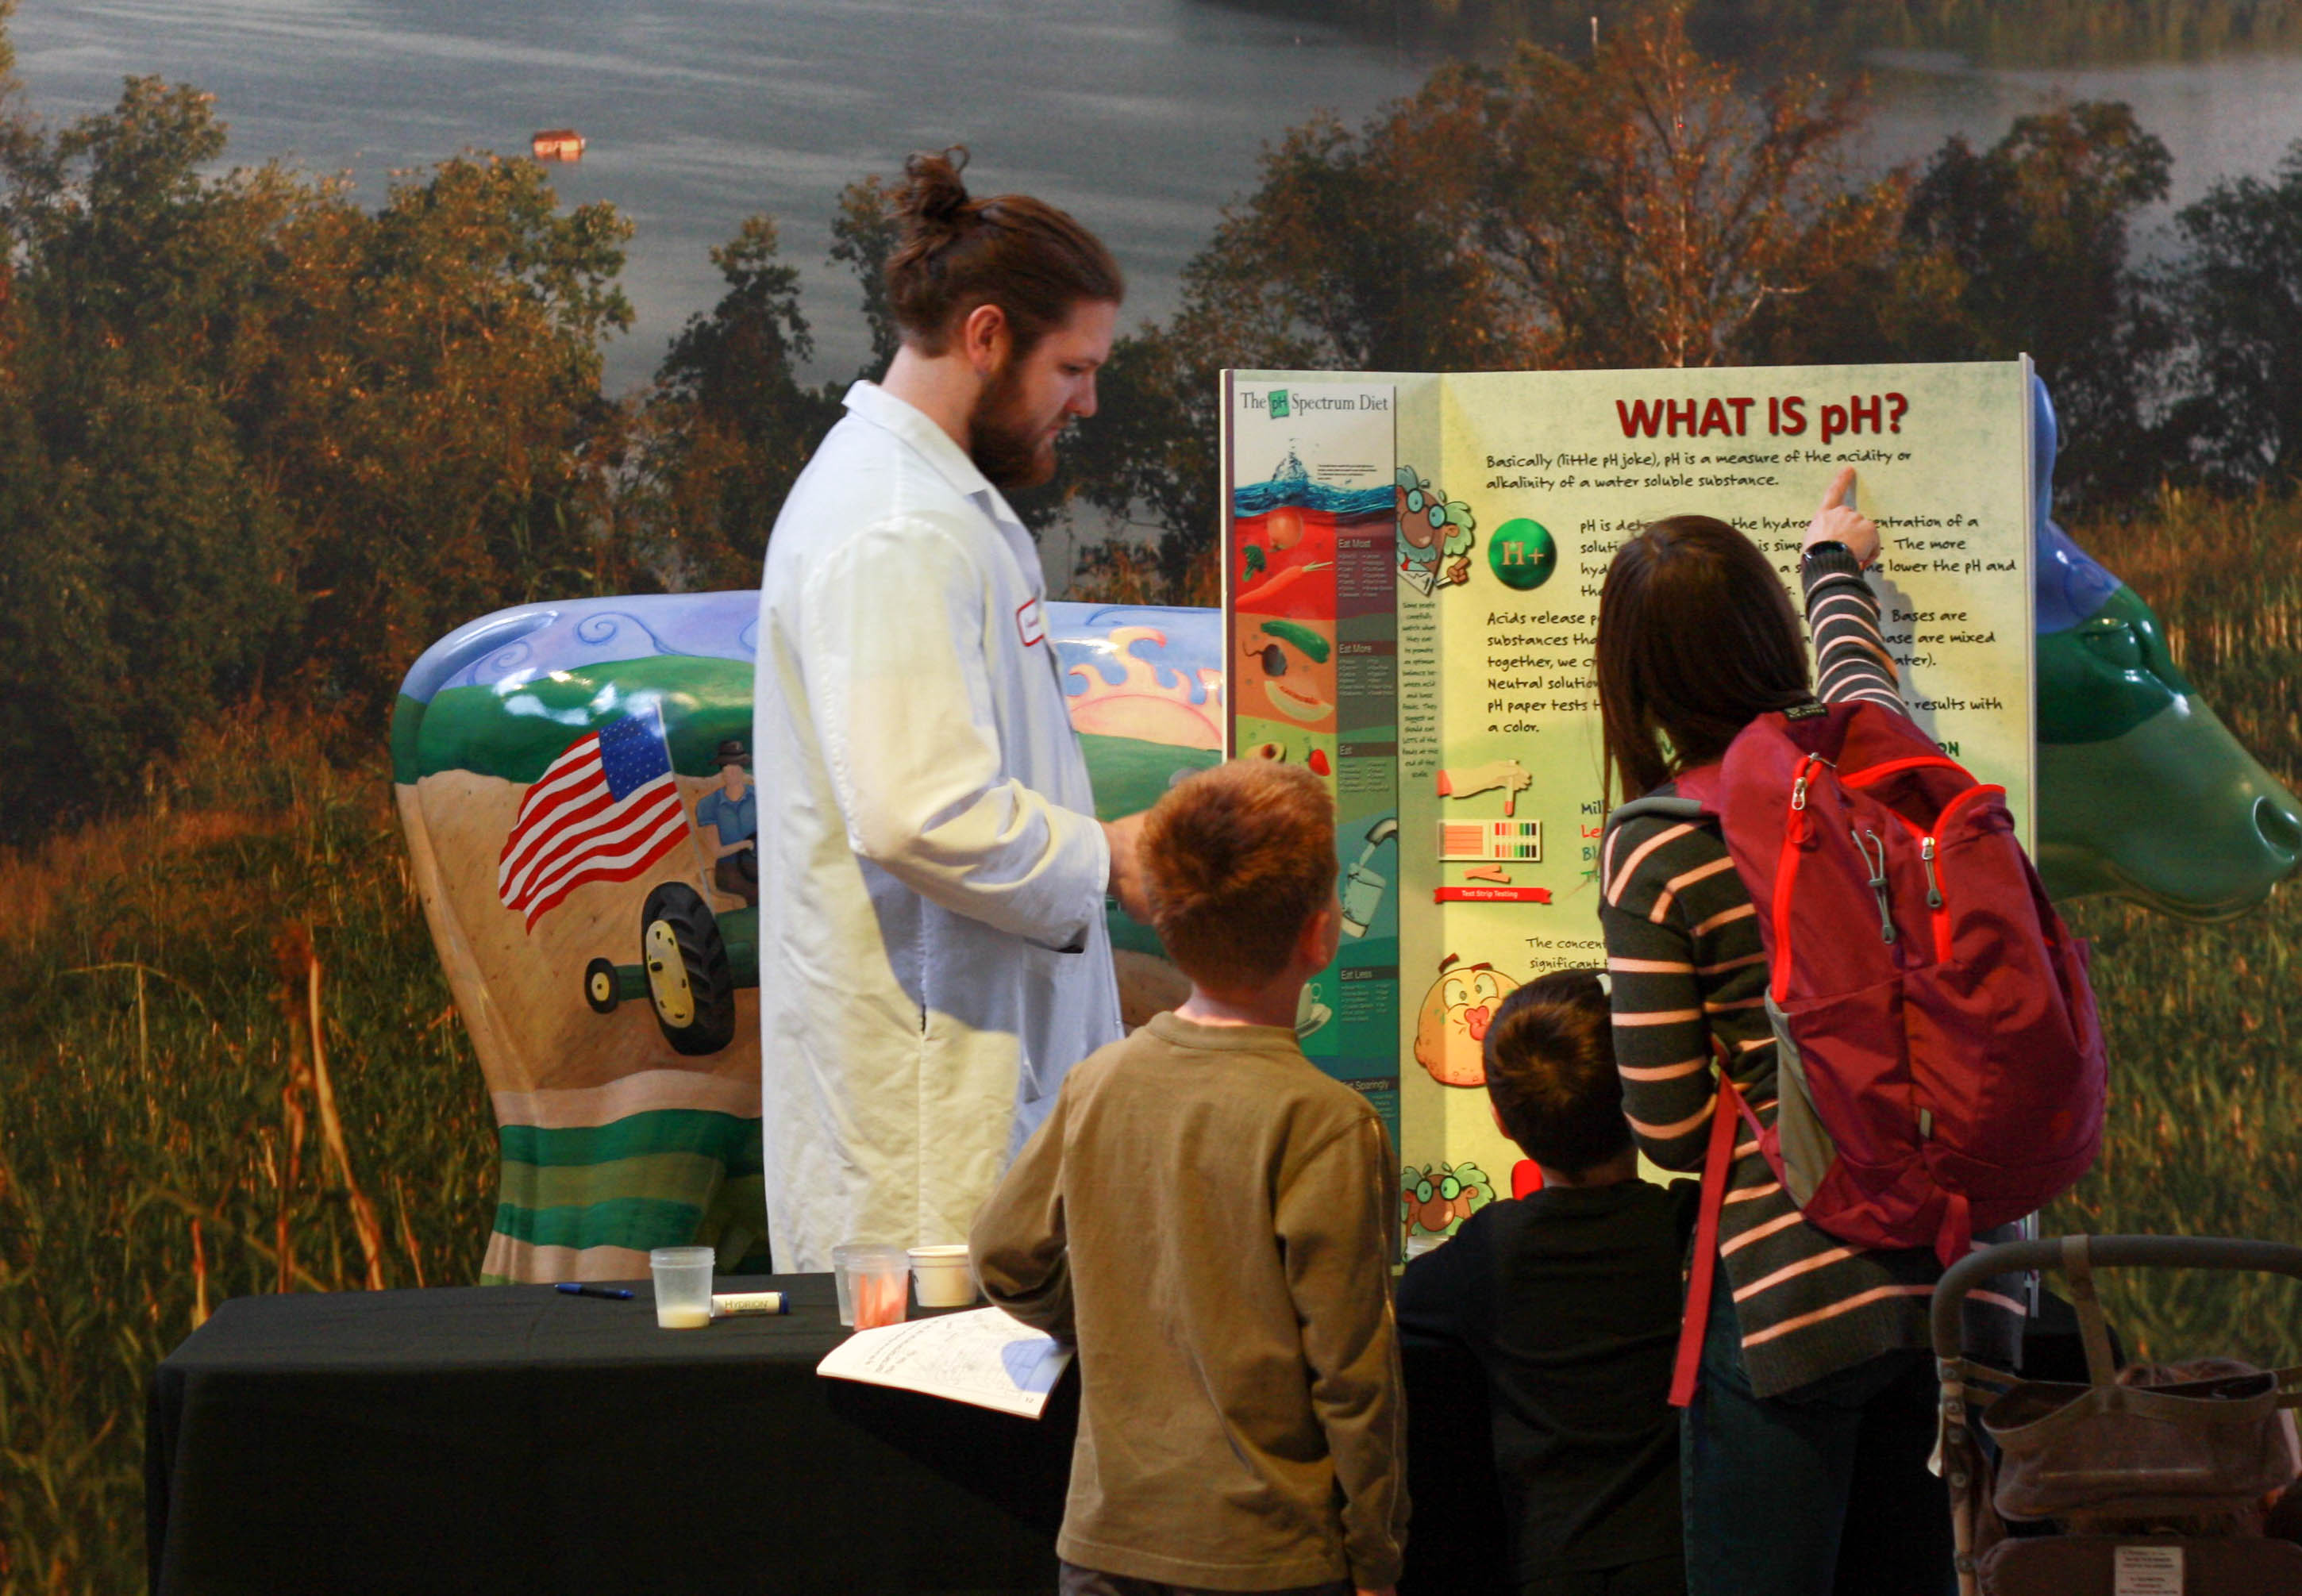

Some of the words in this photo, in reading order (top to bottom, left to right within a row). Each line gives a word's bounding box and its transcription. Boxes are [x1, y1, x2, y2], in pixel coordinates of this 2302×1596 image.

[1240, 392, 1266, 409] The
[1272, 397, 1287, 413] pH
[1292, 394, 1355, 416] Spectrum
[1359, 394, 1388, 410] Diet
[1615, 398, 1755, 437] WHAT
[1769, 396, 1807, 436] IS
[1821, 392, 1909, 445] pH?
[1487, 455, 1552, 470] Basically
[1557, 453, 1597, 468] (little
[1603, 454, 1619, 469] pH
[1621, 453, 1661, 470] joke),
[1665, 453, 1680, 468] pH
[1685, 452, 1696, 464] is
[1716, 452, 1780, 464] measure
[1785, 450, 1801, 463] of
[1805, 450, 1832, 463] the
[1837, 449, 1892, 465] acidity
[1897, 452, 1911, 461] or
[1487, 476, 1555, 491] alkalinity
[1560, 476, 1576, 488] of
[1595, 478, 1639, 488] water
[1645, 475, 1696, 487] soluble
[1699, 475, 1779, 487] substance.
[1580, 519, 1596, 533] pH
[1600, 519, 1611, 532] is
[1731, 516, 1757, 529] the
[1873, 515, 1942, 529] entration
[1946, 513, 1962, 527] of
[1968, 518, 1979, 527] a
[1338, 539, 1350, 548] Eat
[1352, 539, 1372, 548] Most
[1580, 540, 1619, 553] soluti
[1757, 539, 1769, 552] is
[1774, 539, 1803, 553] simp
[1893, 537, 1925, 550] The
[1930, 540, 1966, 550] more
[1888, 559, 1927, 572] lower
[1933, 559, 1960, 572] the
[1965, 560, 1981, 575] pH
[1986, 560, 2017, 572] and
[1487, 612, 1526, 625] Acids
[1530, 611, 1585, 624] release
[1892, 610, 1935, 622] Bases
[1940, 611, 1968, 621] are
[1487, 635, 1569, 646] substances
[1573, 633, 1598, 644] tha
[1886, 634, 1912, 644] ase
[1918, 634, 1945, 644] are
[1950, 632, 1996, 643] mixed
[1339, 644, 1351, 654] Eat
[1353, 644, 1372, 654] More
[1487, 655, 1553, 672] together,
[1557, 658, 1578, 667] we
[1896, 652, 1936, 668] ater).
[1488, 676, 1542, 690] Neutral
[1488, 698, 1503, 713] pH
[1507, 701, 1547, 713] paper
[1552, 698, 1588, 711] tests
[1915, 697, 1965, 710] results
[1970, 697, 2003, 710] with
[1488, 723, 1499, 733] a
[1503, 720, 1540, 733] color.
[1476, 890, 1492, 899] Strip
[1494, 890, 1519, 899] Testing
[1526, 936, 1553, 948] The
[1530, 956, 1599, 972] significant
[1341, 970, 1353, 979] Eat
[724, 1300, 769, 1309] HYDRION
